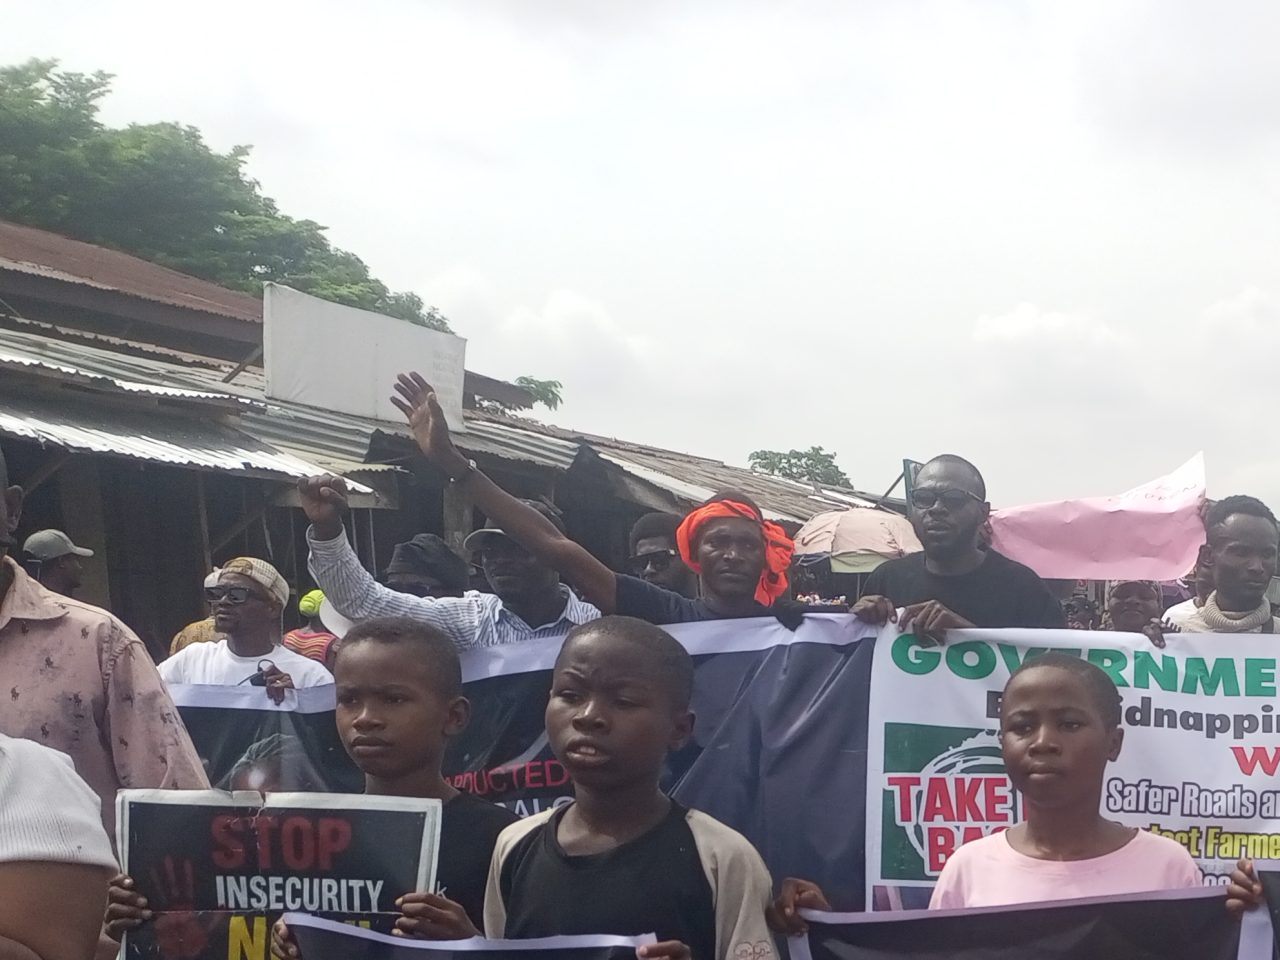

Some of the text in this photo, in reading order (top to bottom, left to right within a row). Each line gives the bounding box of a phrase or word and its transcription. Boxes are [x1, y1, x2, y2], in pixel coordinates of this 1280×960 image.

[888, 777, 1009, 822] TAKE
[1106, 777, 1179, 815] Safer
[1181, 782, 1257, 818] Roads
[210, 815, 352, 871] STOP
[216, 875, 384, 912] INSECURITY
